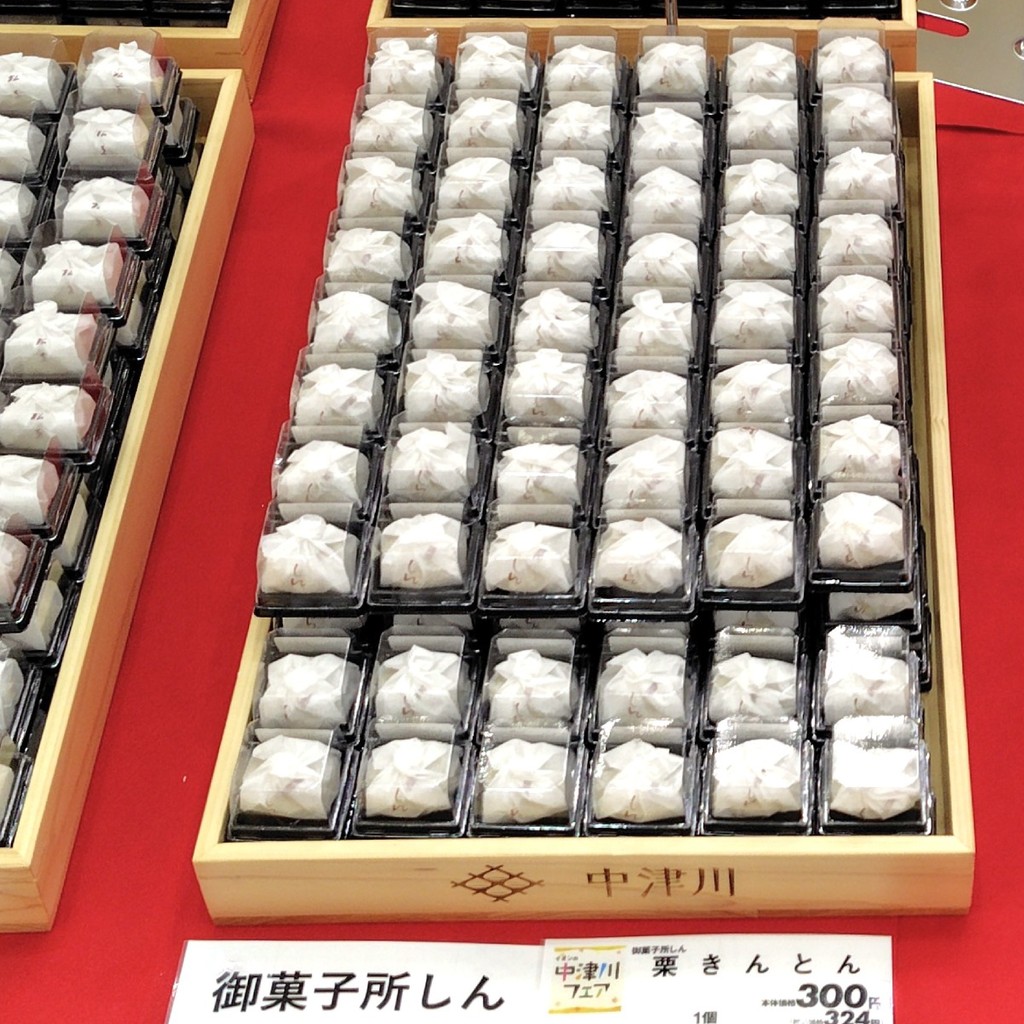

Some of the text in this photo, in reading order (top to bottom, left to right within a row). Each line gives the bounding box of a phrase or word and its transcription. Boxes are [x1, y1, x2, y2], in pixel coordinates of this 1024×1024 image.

[586, 866, 737, 900] 中津川
[555, 961, 621, 982] 中津川
[652, 953, 861, 977] 栗きんとん
[212, 971, 507, 1014] 御菓子所しん
[563, 983, 611, 999] フェア
